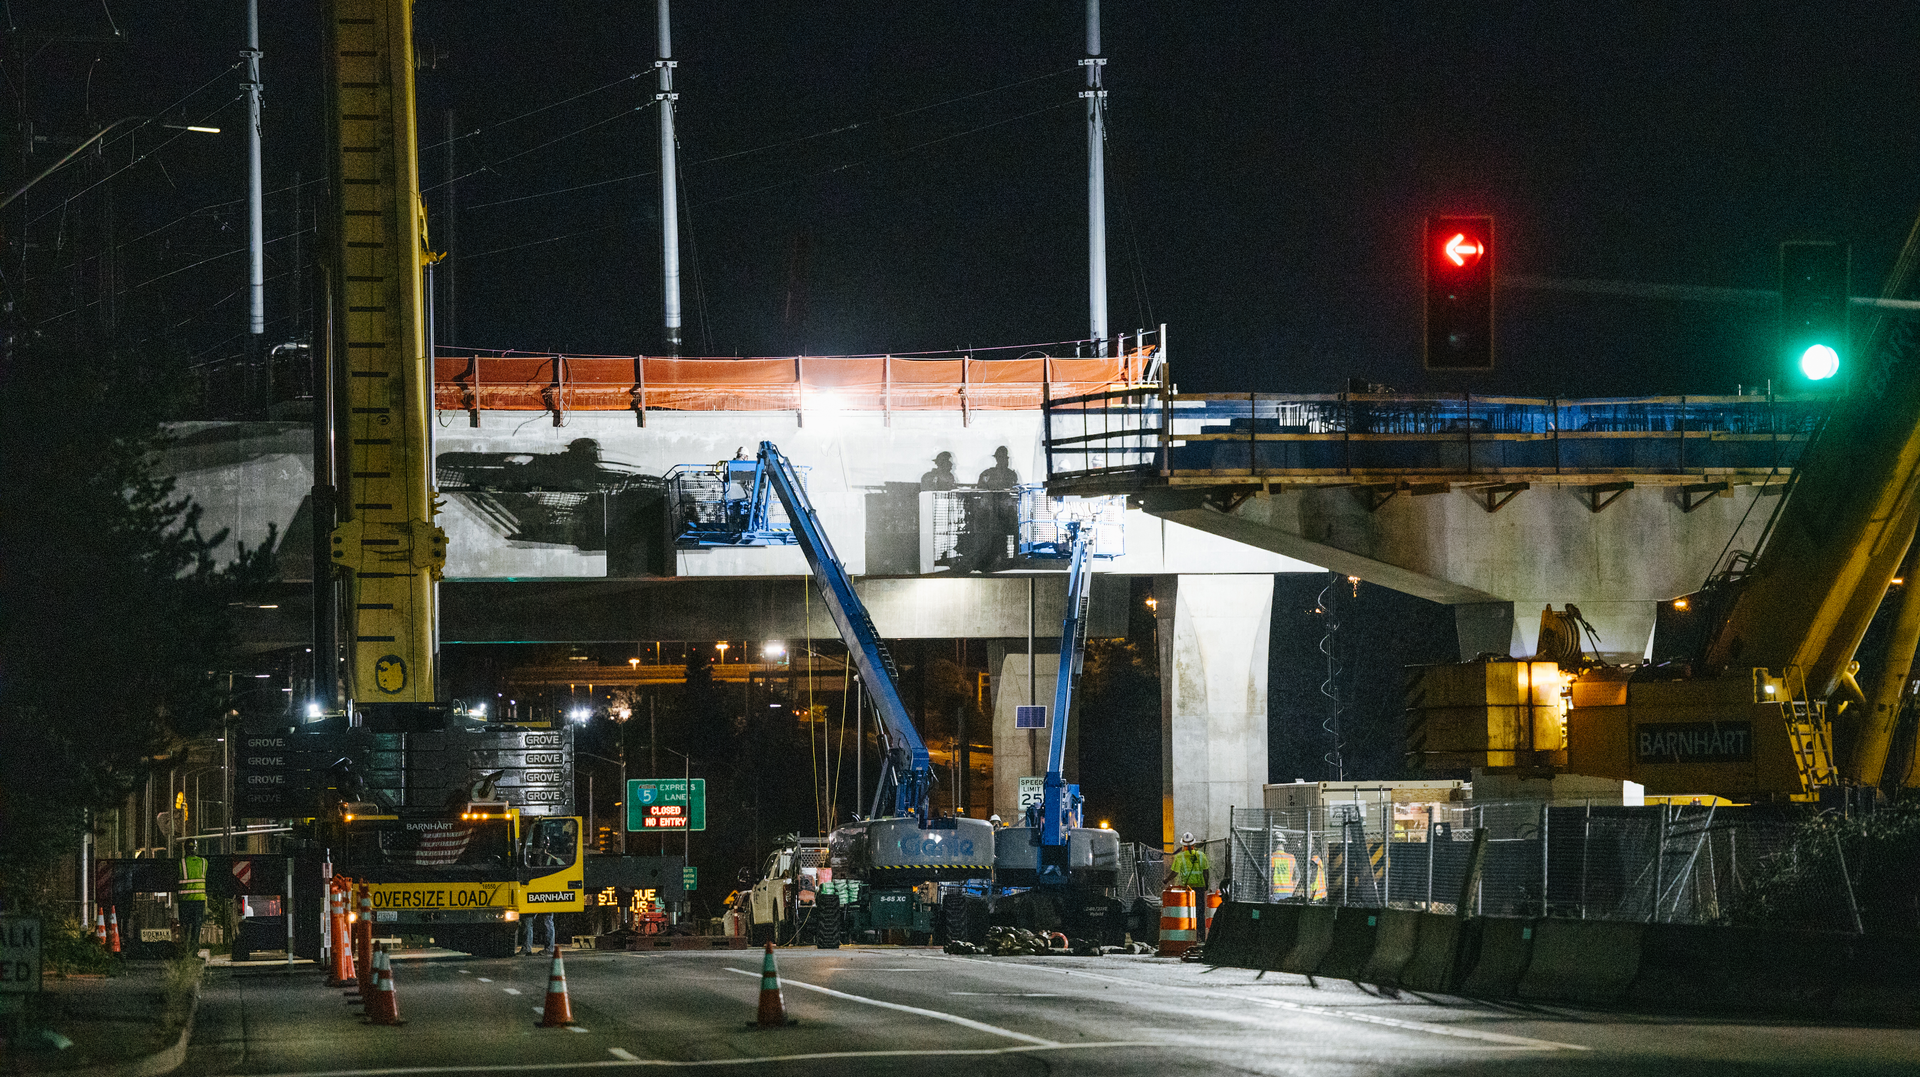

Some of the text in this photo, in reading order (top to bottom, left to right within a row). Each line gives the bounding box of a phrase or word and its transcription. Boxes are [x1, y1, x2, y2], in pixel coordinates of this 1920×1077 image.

[1639, 721, 1748, 762] BARNHART
[660, 783, 696, 791] EXPRES
[643, 790, 652, 802] 5
[1021, 793, 1043, 806] 25
[650, 806, 682, 816] CLOSED
[406, 820, 454, 832] BARNHART
[644, 817, 687, 827] NO ENTRY
[373, 890, 488, 907] OVERSIZE LOAD
[528, 891, 575, 903] BARNHART
